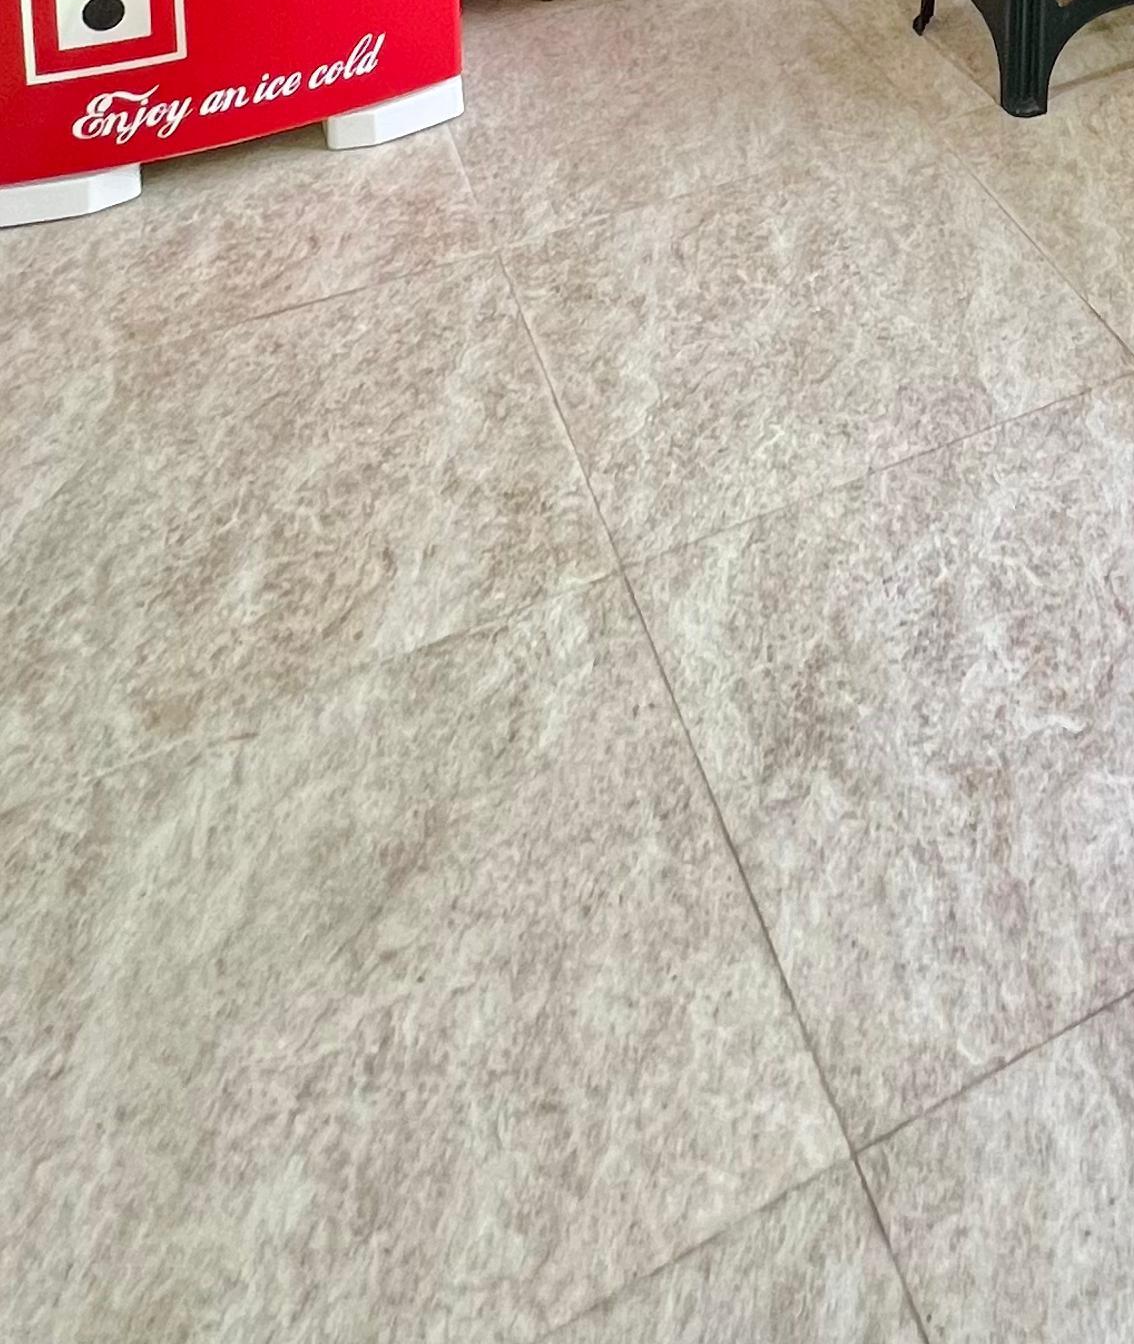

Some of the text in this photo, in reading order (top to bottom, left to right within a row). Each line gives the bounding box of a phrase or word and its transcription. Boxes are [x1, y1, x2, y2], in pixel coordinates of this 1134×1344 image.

[72, 31, 387, 145] Enjoy an ice cold
